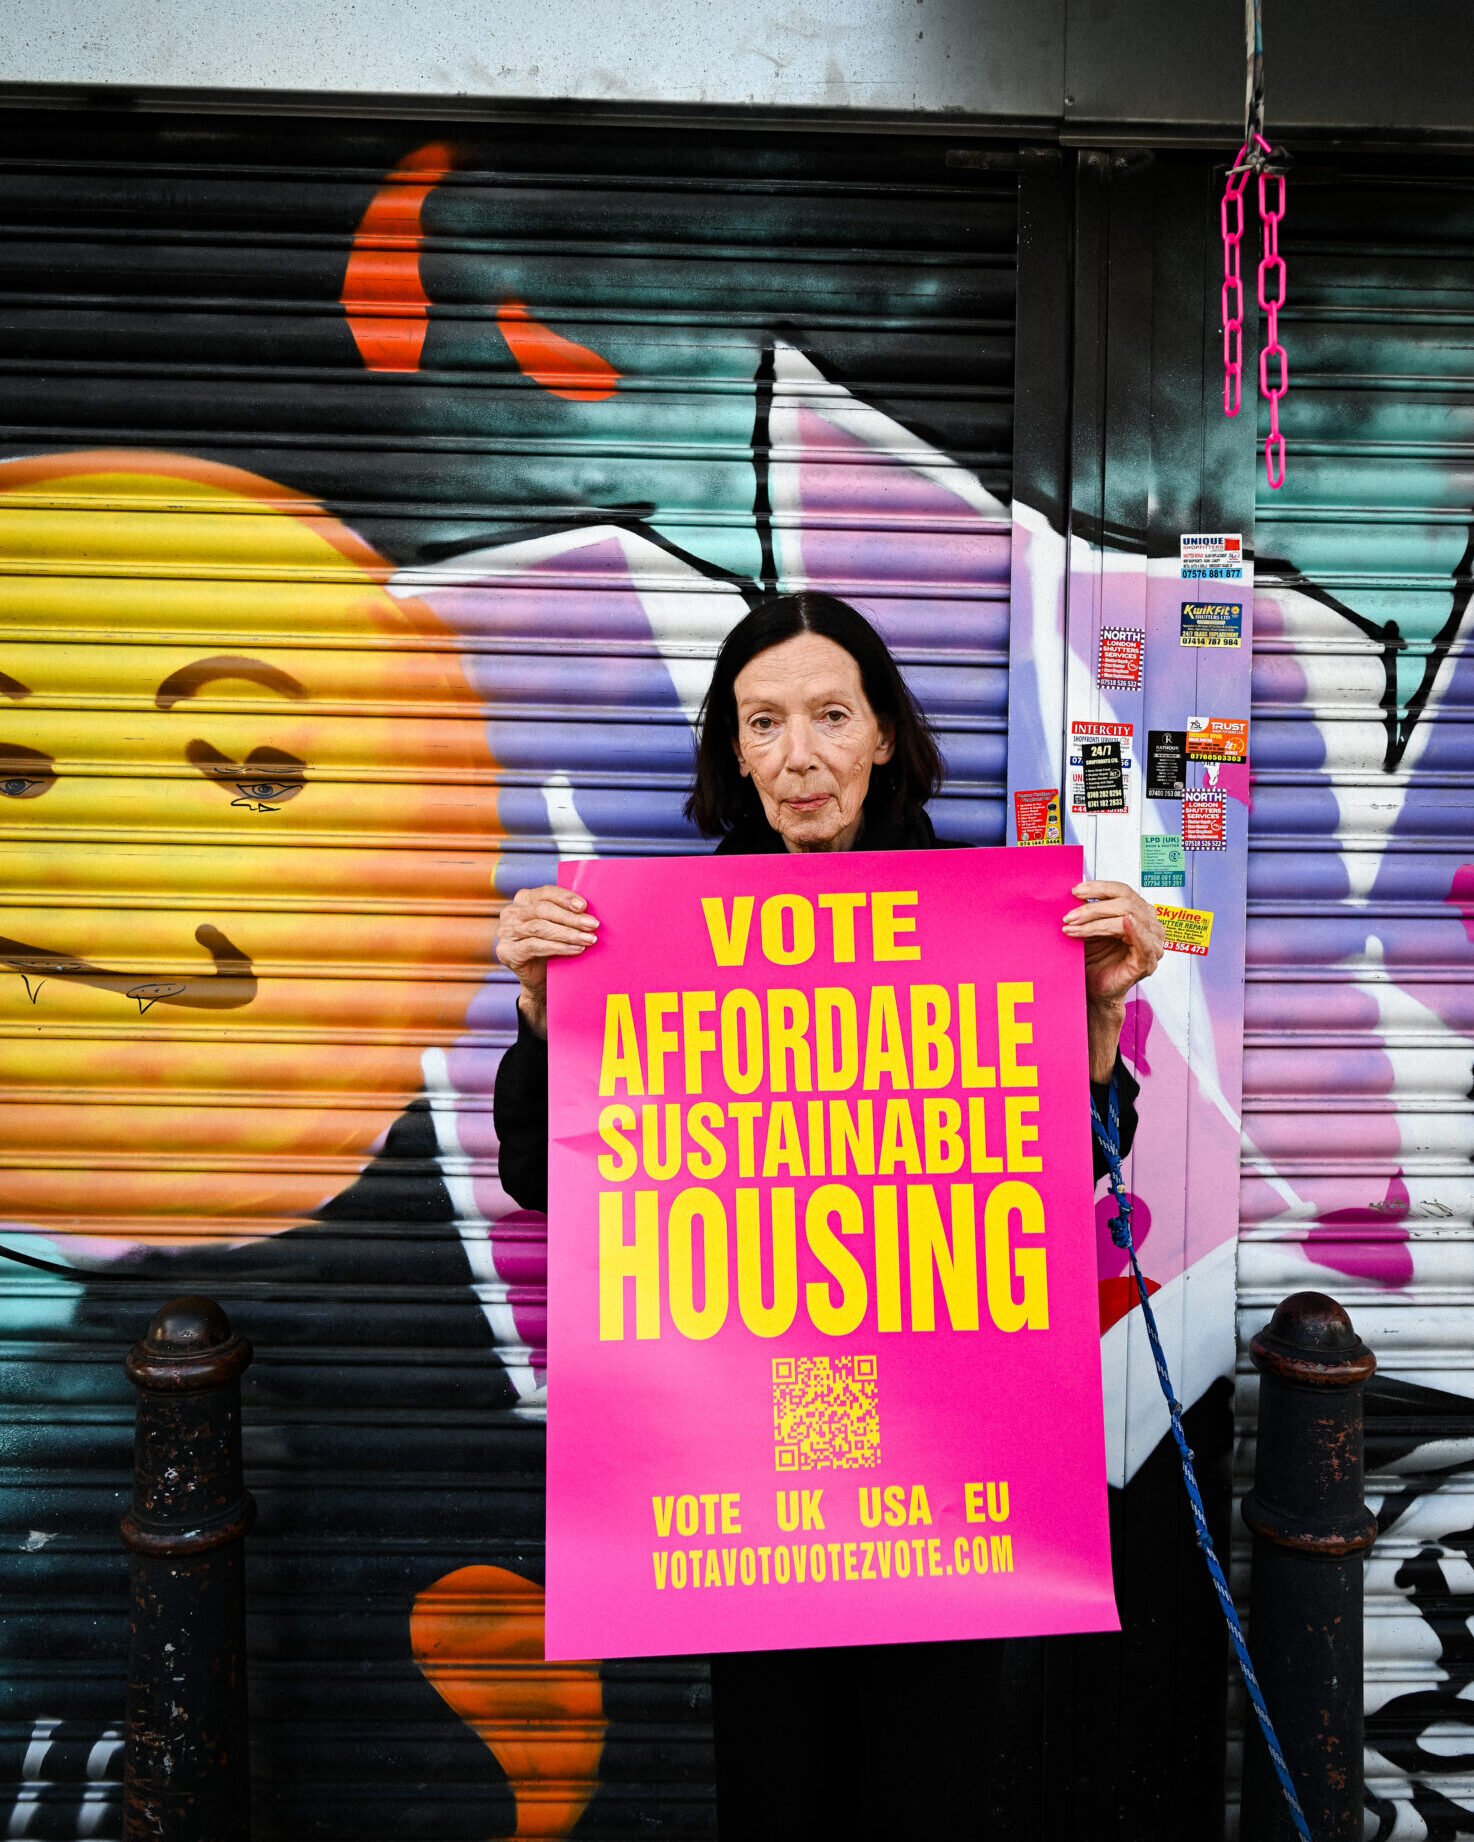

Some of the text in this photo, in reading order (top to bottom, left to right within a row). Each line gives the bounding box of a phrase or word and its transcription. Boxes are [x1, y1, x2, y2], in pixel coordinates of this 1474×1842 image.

[1183, 537, 1223, 545] UNIQUE
[1182, 569, 1240, 578] 07576 881 877
[1103, 630, 1141, 641] NORTH
[1074, 724, 1131, 735] INTERCITY
[1211, 722, 1246, 731] TRUST
[1091, 745, 1112, 756] 24/7
[1185, 792, 1222, 801] NORTH
[1156, 906, 1202, 921] Skyline
[701, 891, 921, 966] VOTE
[1185, 922, 1208, 931] REPAIR
[598, 982, 1039, 1095] AFFORDABLE
[598, 1096, 1043, 1181] SUSTAINABLE
[599, 1181, 1049, 1340] HOUSING
[652, 1482, 1009, 1537] VOTE UK USA EU
[653, 1535, 1014, 1589] VOTAVOTOVOTEZVOTE.COM
